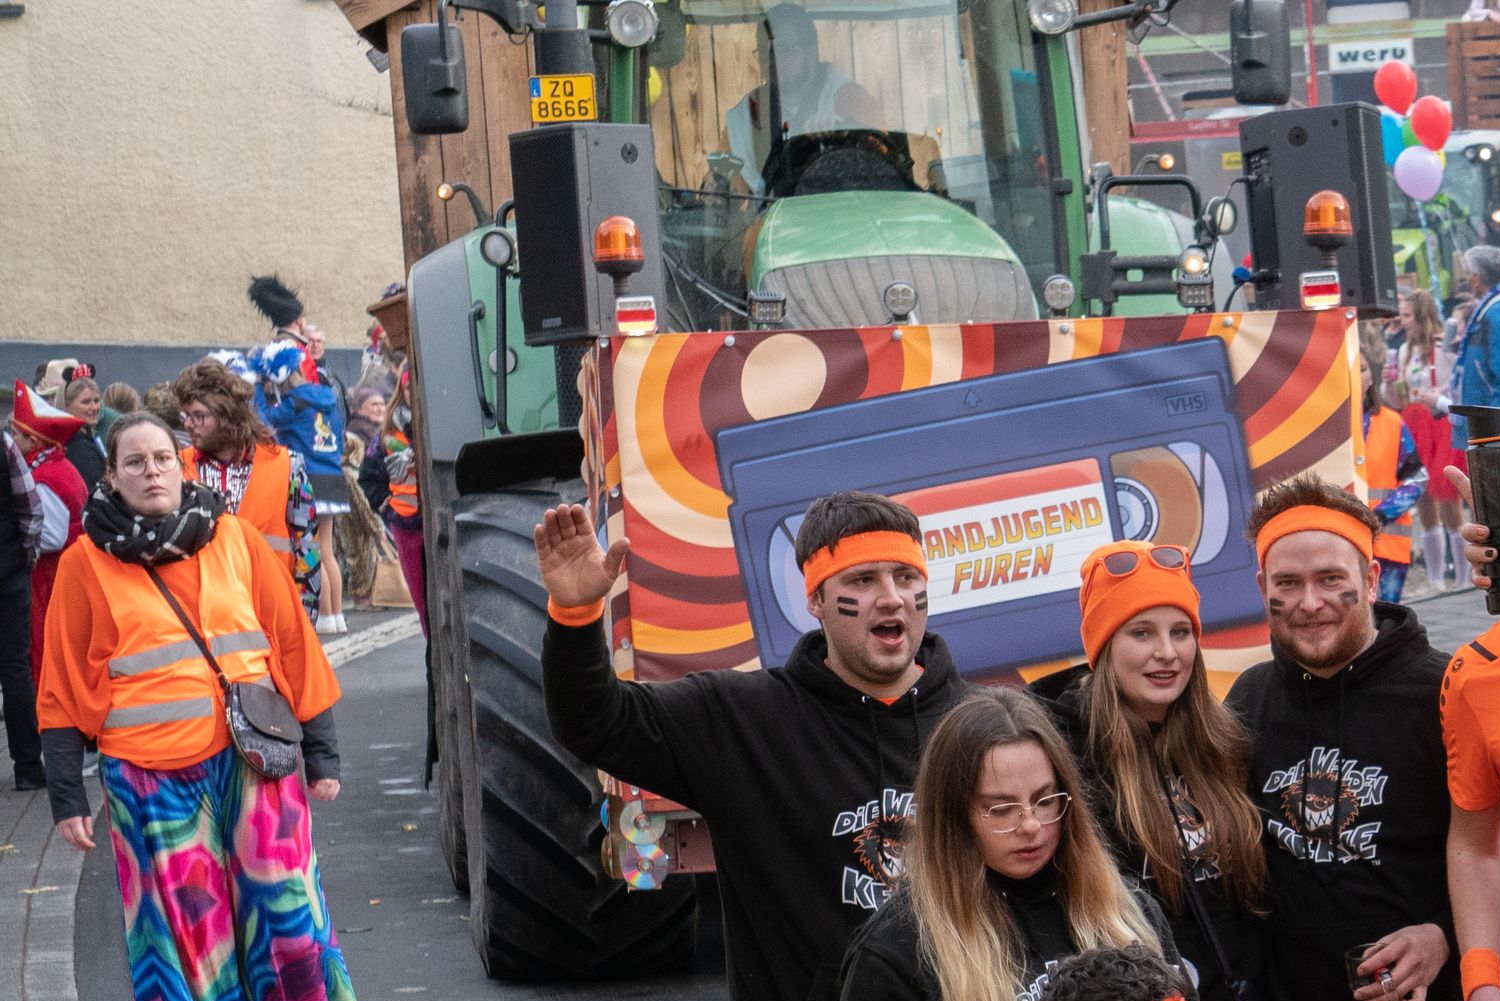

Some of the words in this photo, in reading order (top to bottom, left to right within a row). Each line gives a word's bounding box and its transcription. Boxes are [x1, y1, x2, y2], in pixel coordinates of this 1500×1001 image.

[1338, 47, 1405, 62] weru
[549, 80, 574, 97] ZQ
[538, 100, 589, 118] 8666
[1169, 394, 1203, 411] VHS
[923, 497, 1103, 562] ANDJUGEND
[952, 544, 1054, 595] FUREN
